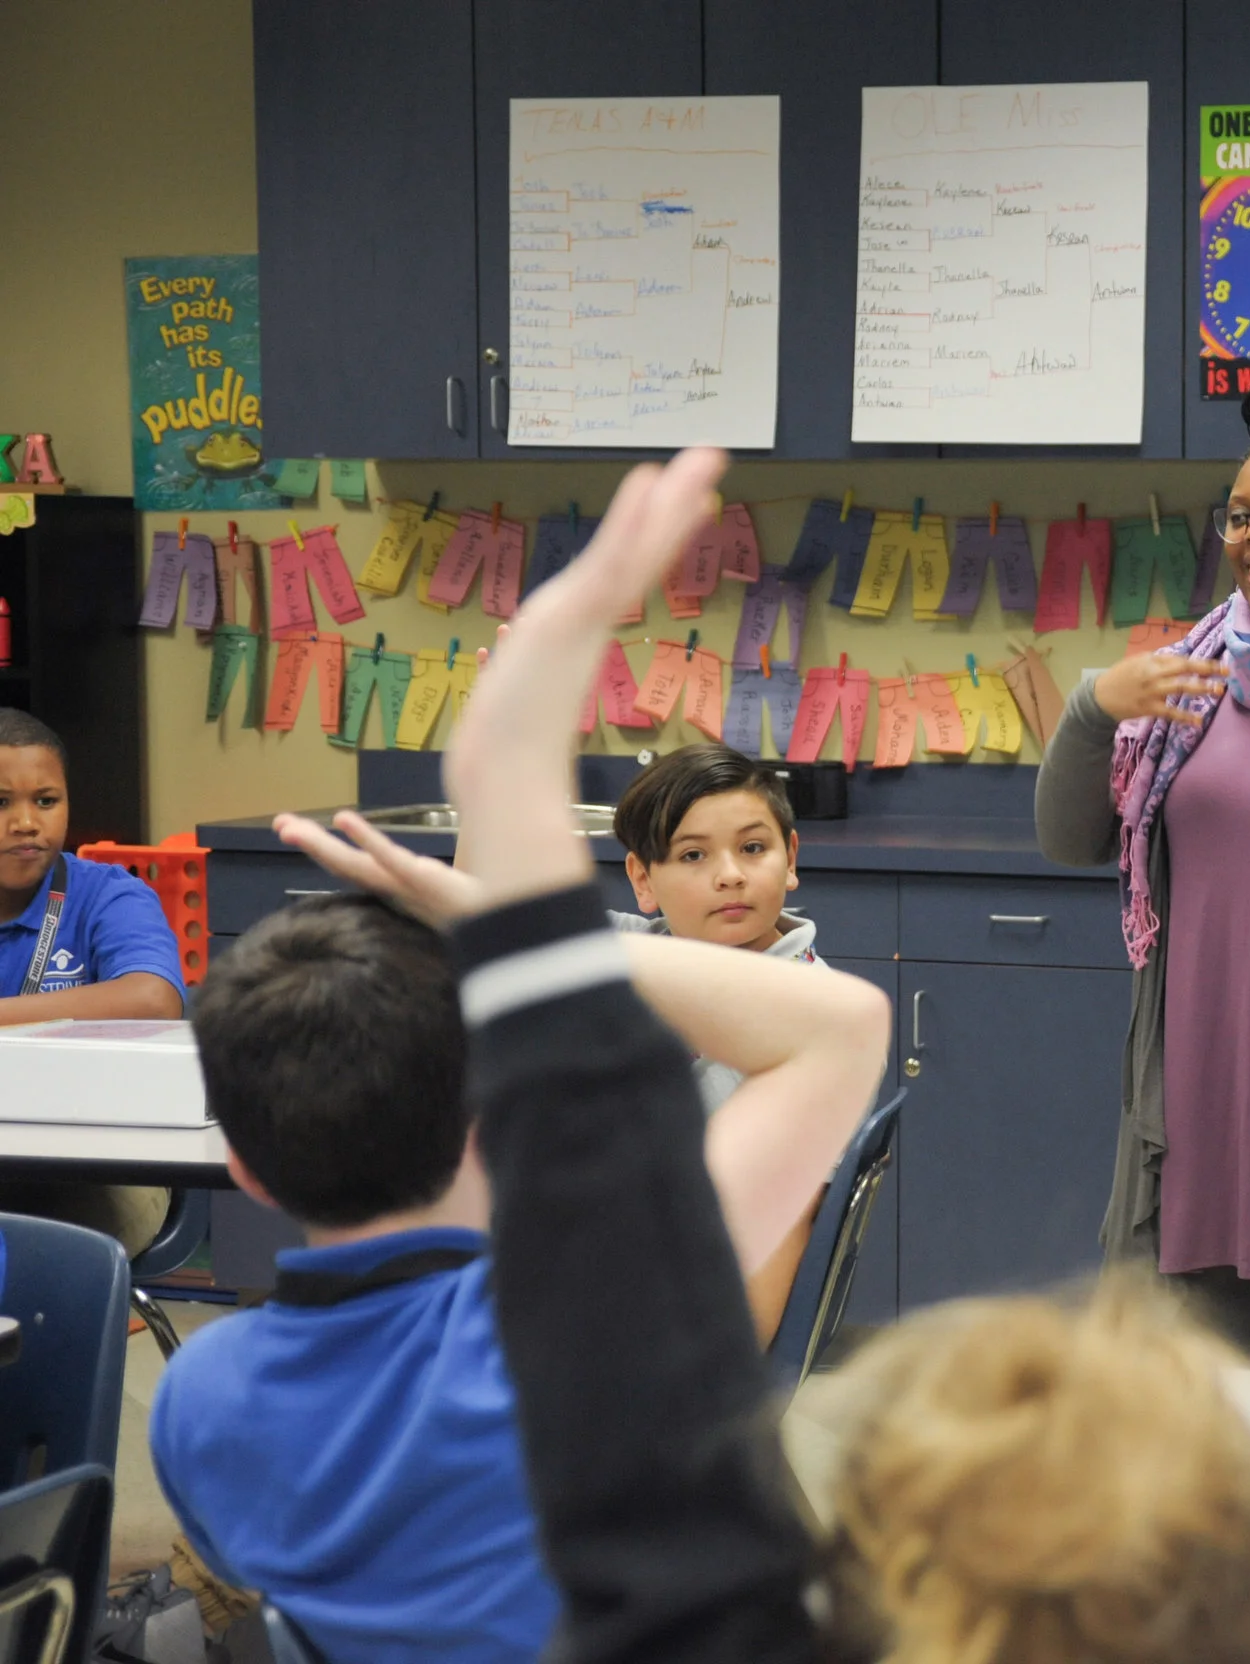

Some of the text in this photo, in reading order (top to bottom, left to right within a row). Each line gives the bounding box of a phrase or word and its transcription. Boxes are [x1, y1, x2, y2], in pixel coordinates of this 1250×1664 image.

[892, 93, 980, 139] OLE
[1214, 237, 1231, 260] 9
[139, 274, 216, 304] Every
[1213, 281, 1231, 303] 8
[171, 296, 234, 325] path
[159, 323, 210, 349] has
[1233, 317, 1250, 339] 7
[185, 345, 223, 369] its
[1207, 361, 1229, 395] is
[140, 366, 263, 445] puddle.
[869, 544, 899, 600] Durham
[410, 684, 439, 724] Diggs
[647, 673, 676, 706] Toth
